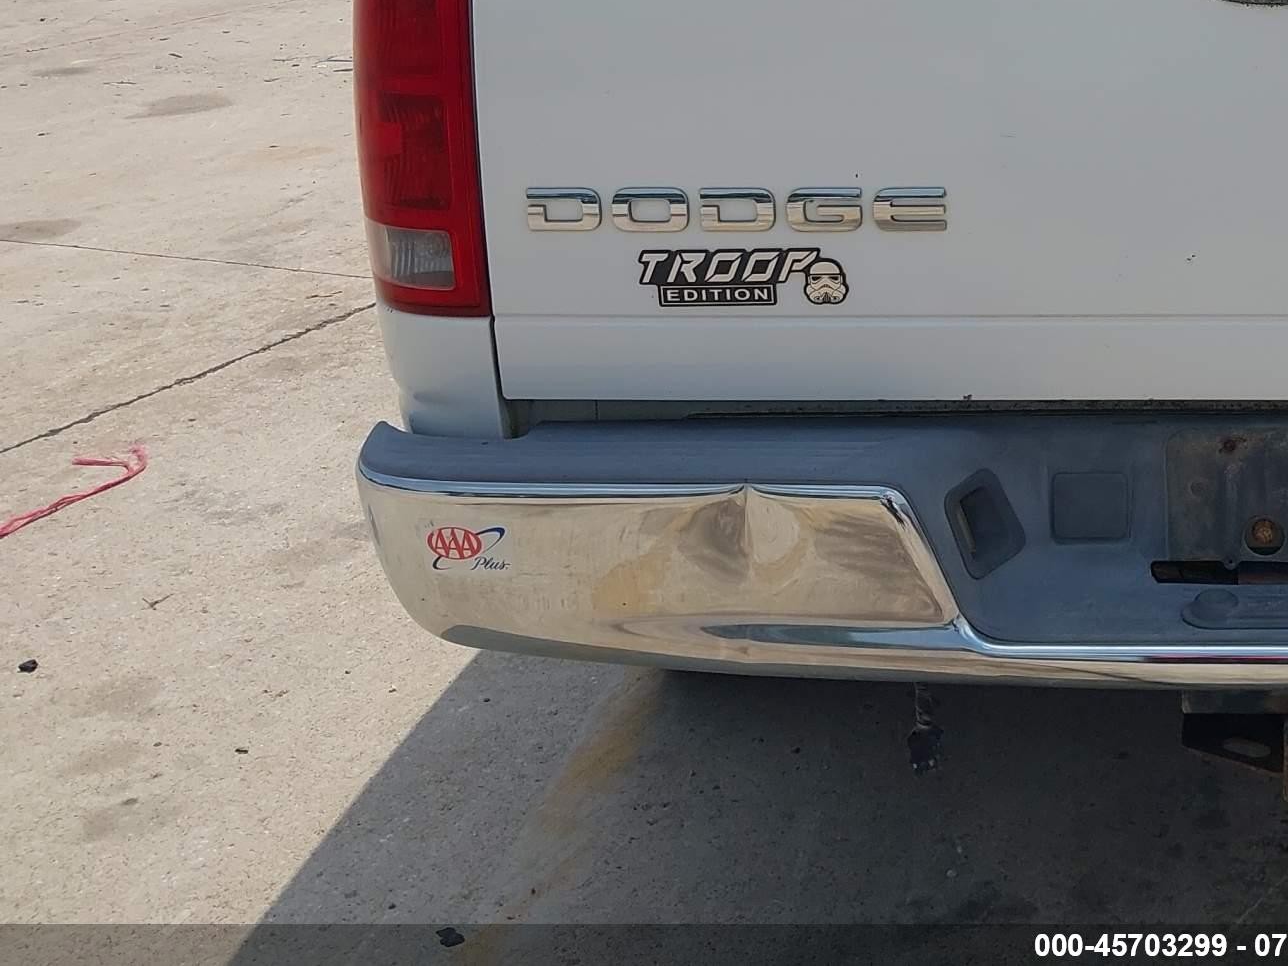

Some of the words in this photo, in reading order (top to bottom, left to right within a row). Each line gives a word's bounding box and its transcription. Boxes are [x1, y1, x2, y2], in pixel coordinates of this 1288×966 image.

[525, 186, 948, 233] DODGE
[638, 250, 818, 284] TROOP
[665, 287, 773, 302] EDITION
[432, 527, 479, 559] AAA
